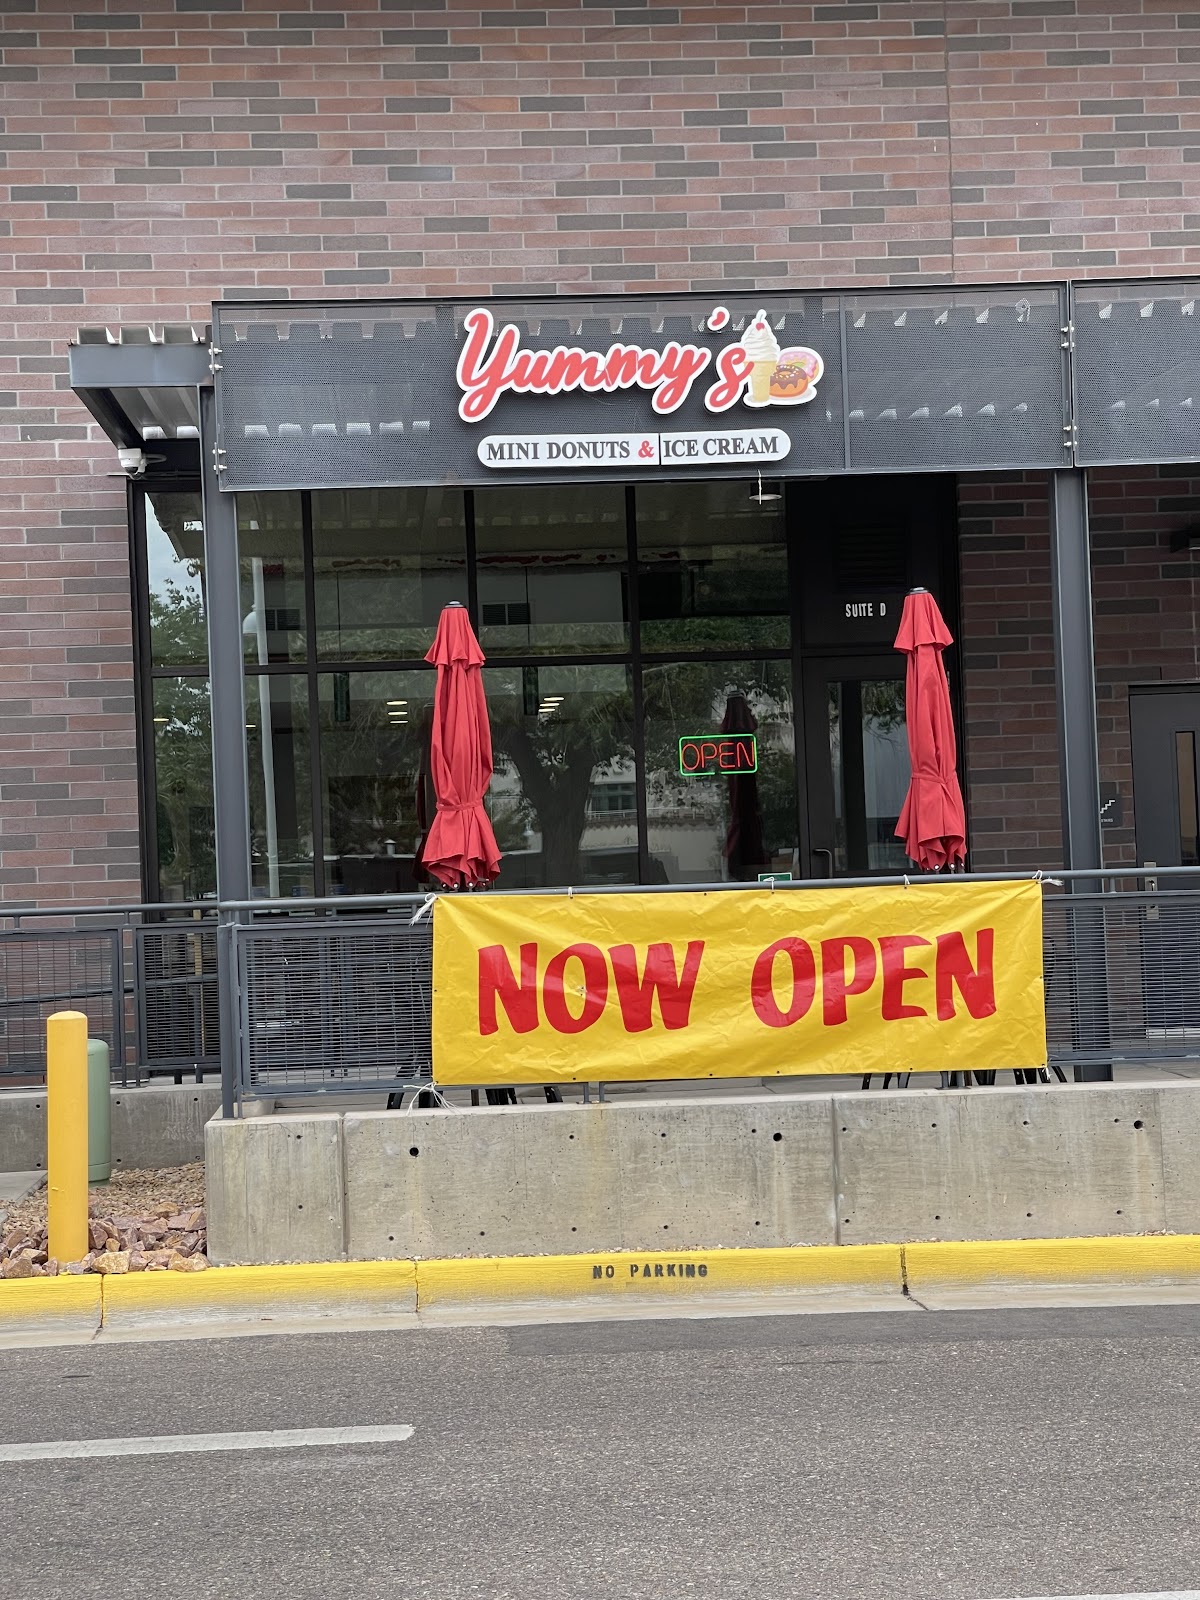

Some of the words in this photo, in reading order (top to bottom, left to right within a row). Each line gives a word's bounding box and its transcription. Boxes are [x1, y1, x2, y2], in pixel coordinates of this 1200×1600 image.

[460, 311, 756, 418] Yummy's
[486, 441, 540, 460] MINI
[546, 440, 631, 459] DONUTS
[637, 440, 655, 458] &
[662, 439, 699, 458] ICE
[702, 436, 779, 457] CREAM
[845, 603, 874, 618] SUITE
[880, 602, 887, 617] D
[682, 741, 755, 771] OPEN
[478, 940, 705, 1036] NOW
[751, 928, 998, 1029] OPEN
[592, 1264, 615, 1279] NO
[630, 1263, 708, 1278] PARKING
